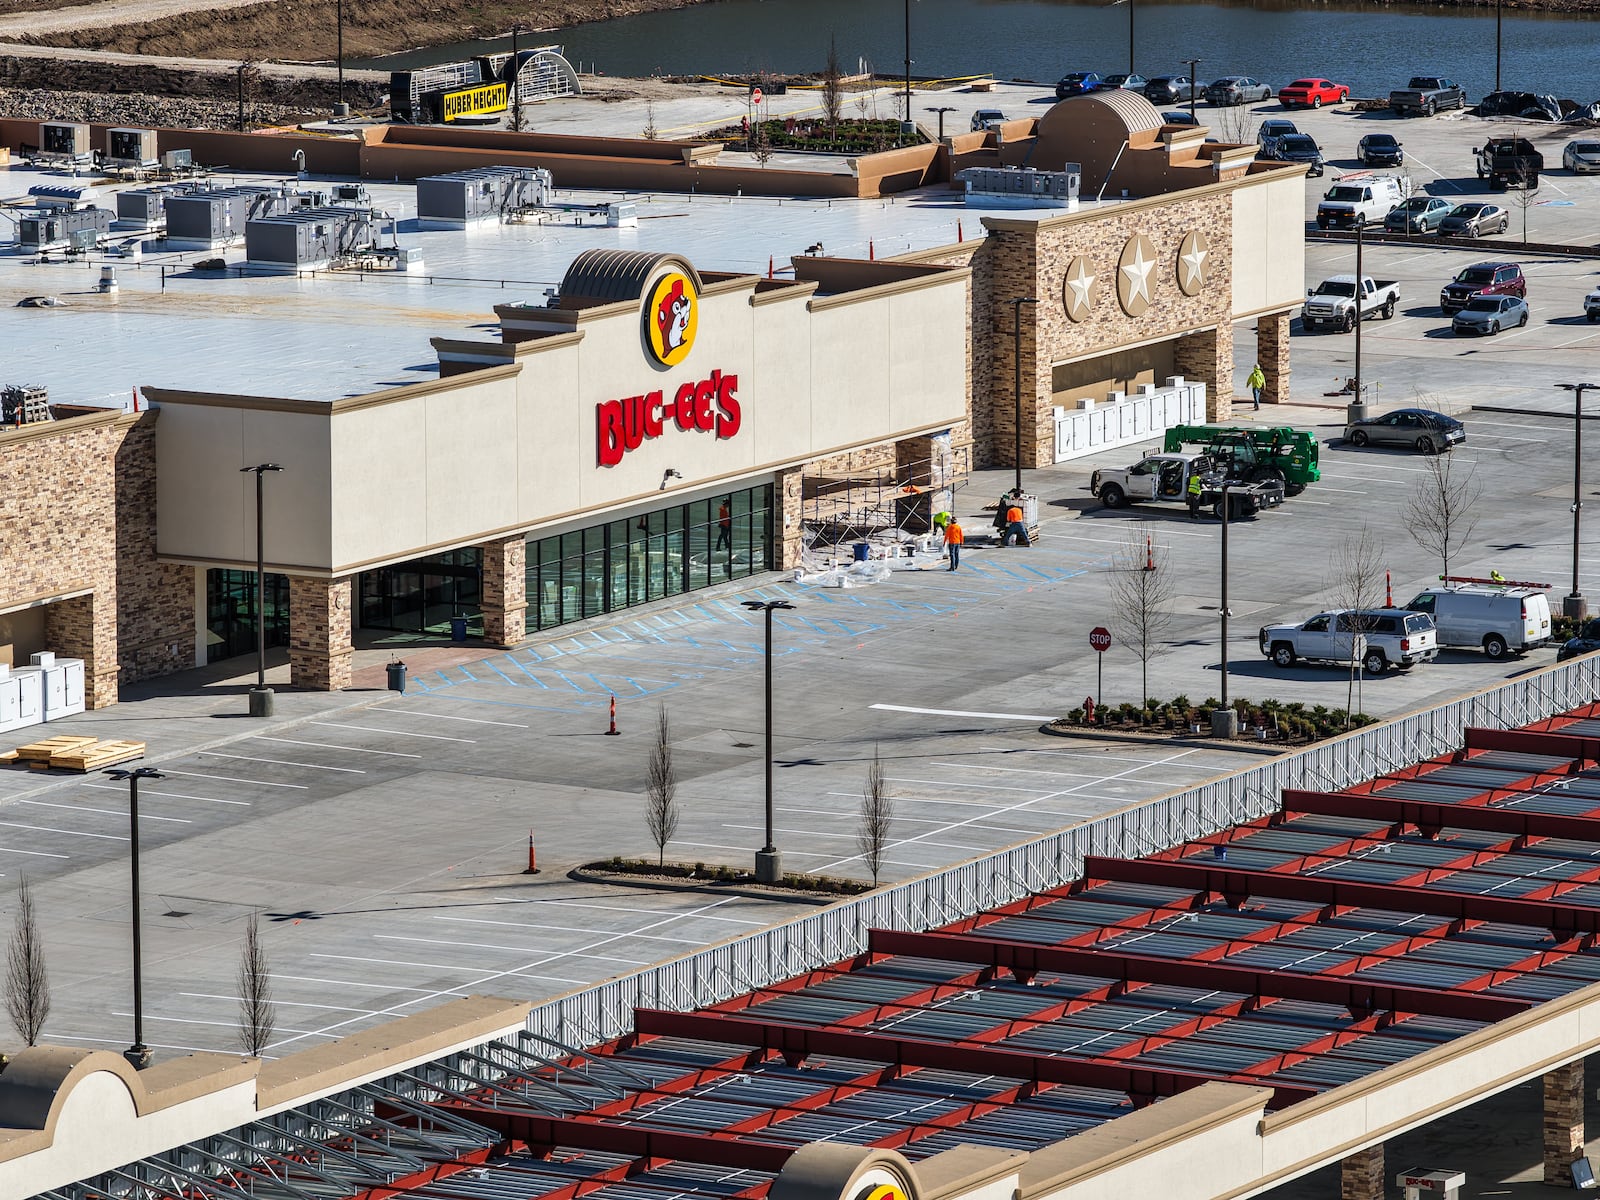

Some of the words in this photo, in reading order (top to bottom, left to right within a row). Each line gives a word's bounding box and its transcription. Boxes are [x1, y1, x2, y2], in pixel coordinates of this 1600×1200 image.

[445, 94, 472, 116] HUBER
[473, 86, 505, 110] HEIGHTS
[1090, 633, 1110, 644] STOP
